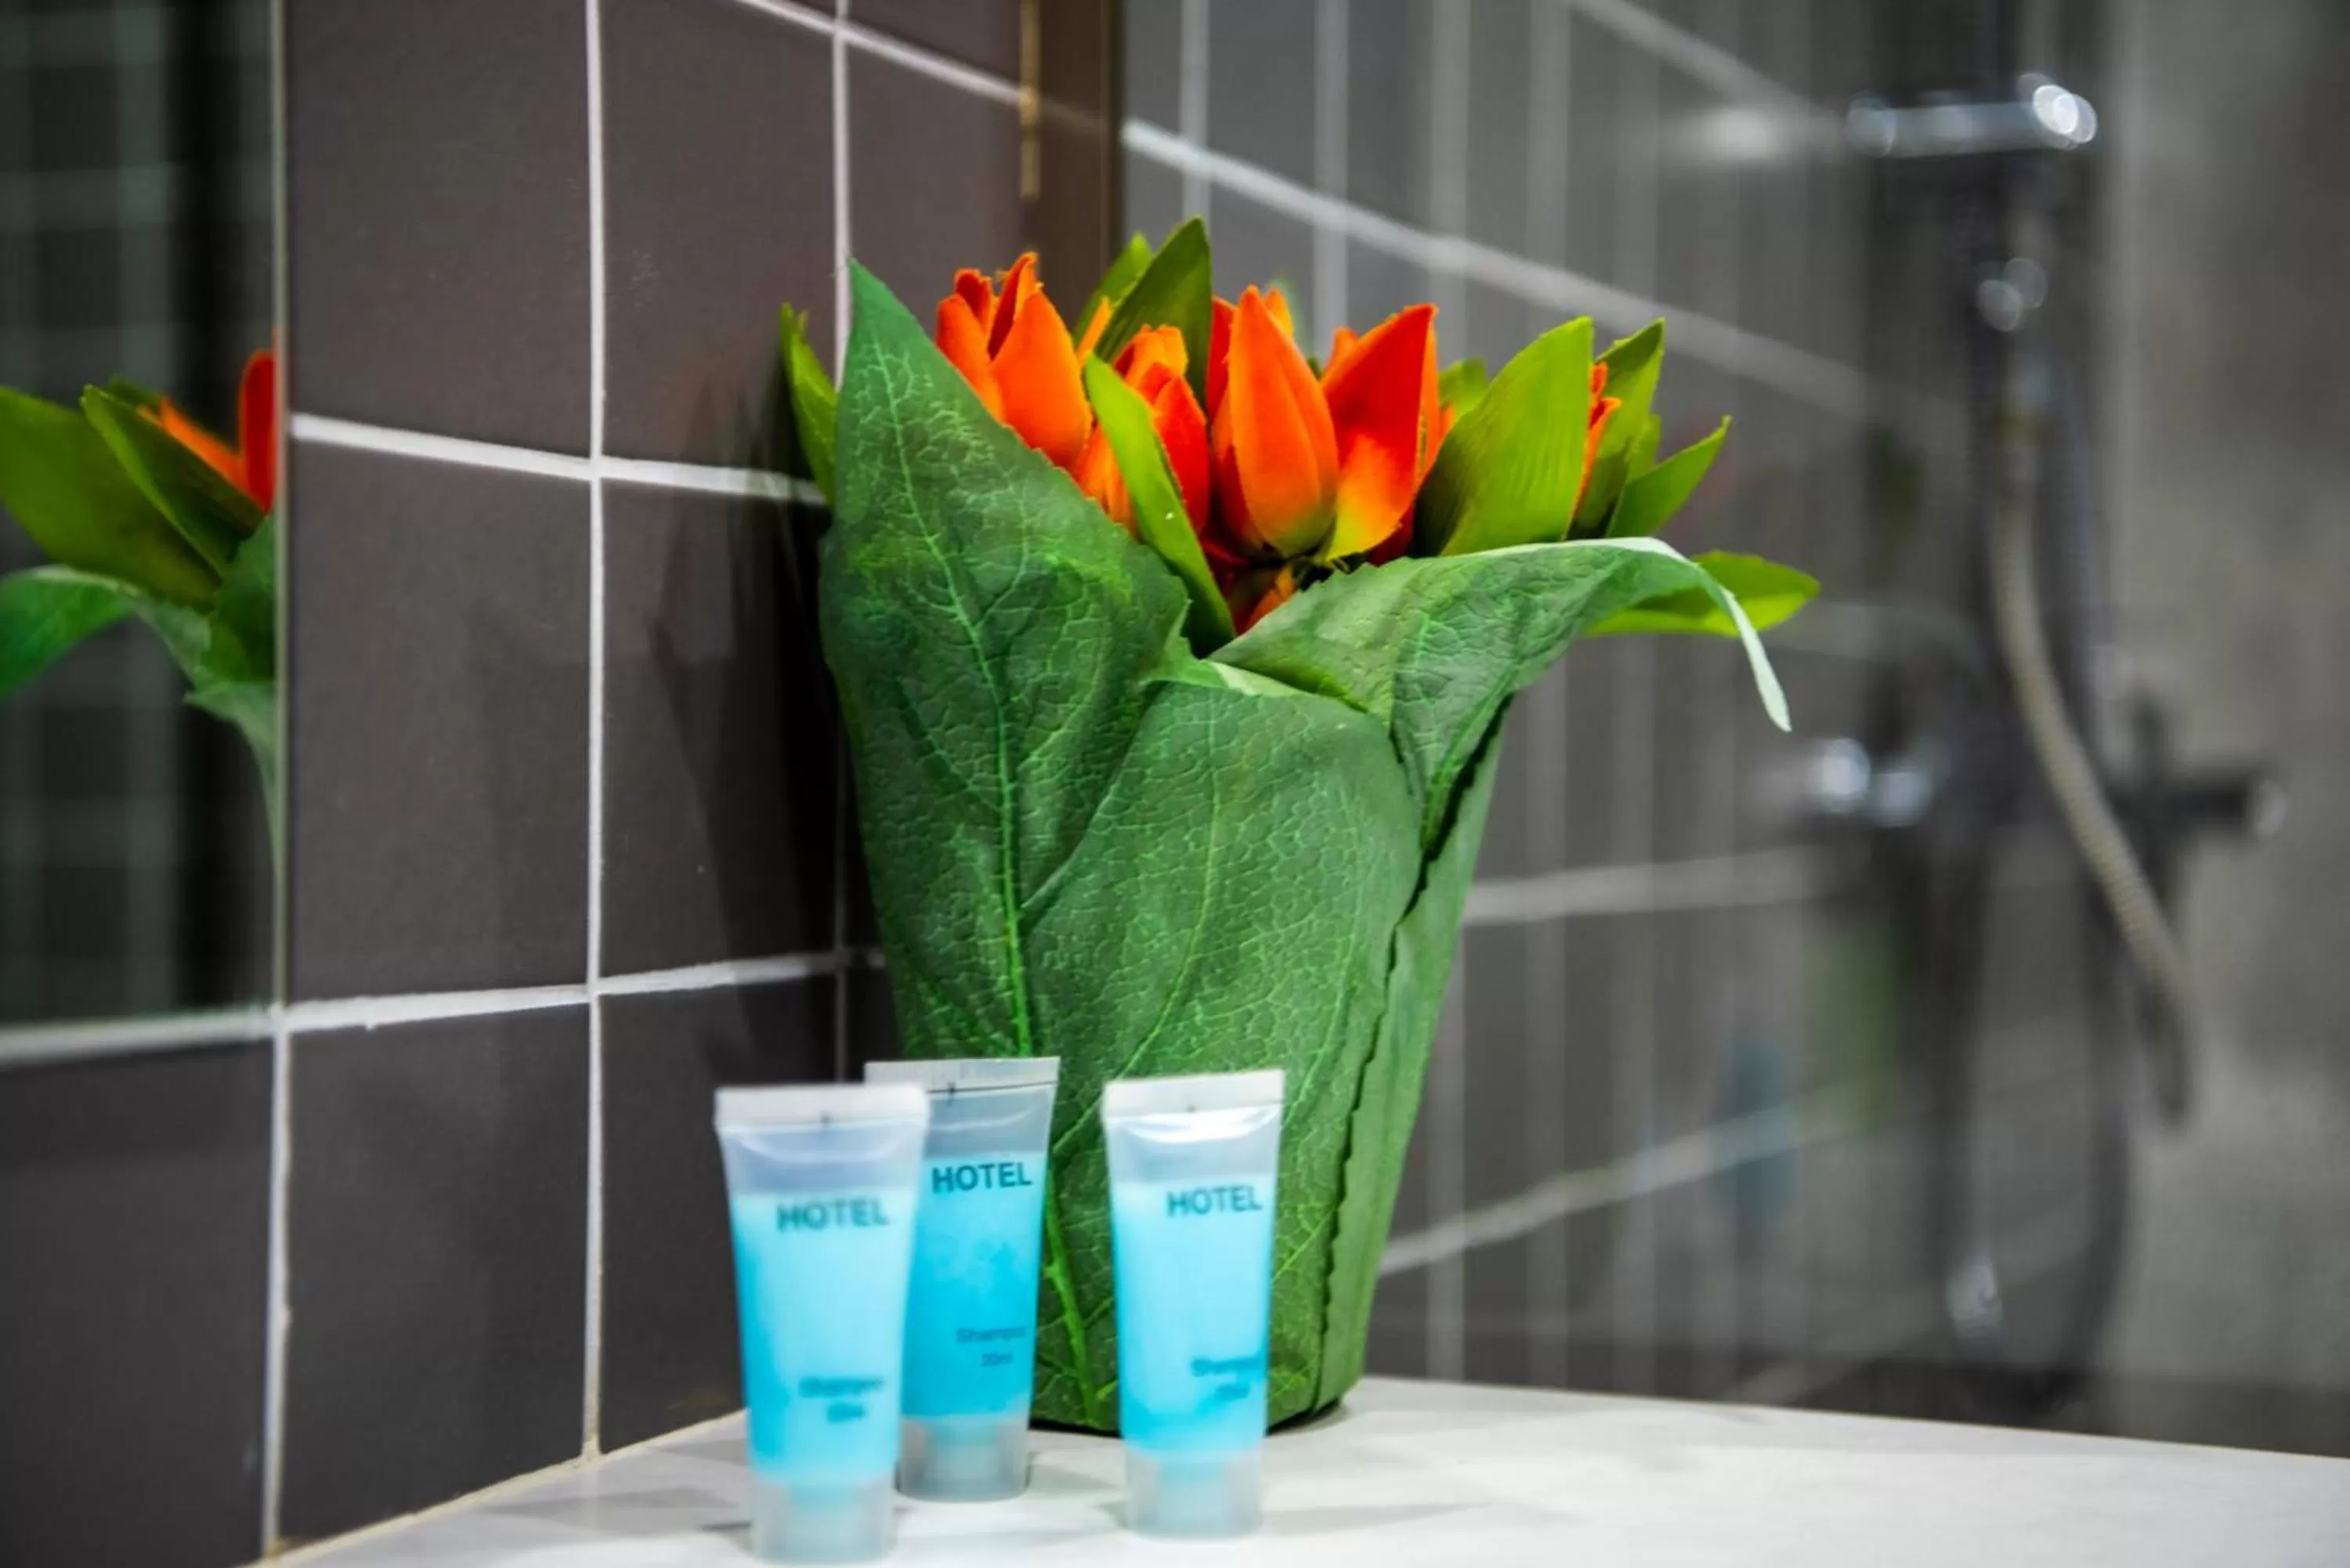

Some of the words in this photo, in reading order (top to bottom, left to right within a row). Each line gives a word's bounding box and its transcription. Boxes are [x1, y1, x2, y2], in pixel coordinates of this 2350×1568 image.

[931, 1162, 1032, 1194] HOTEL
[776, 1196, 890, 1233] HOTEL
[1166, 1185, 1263, 1218] HOTEL
